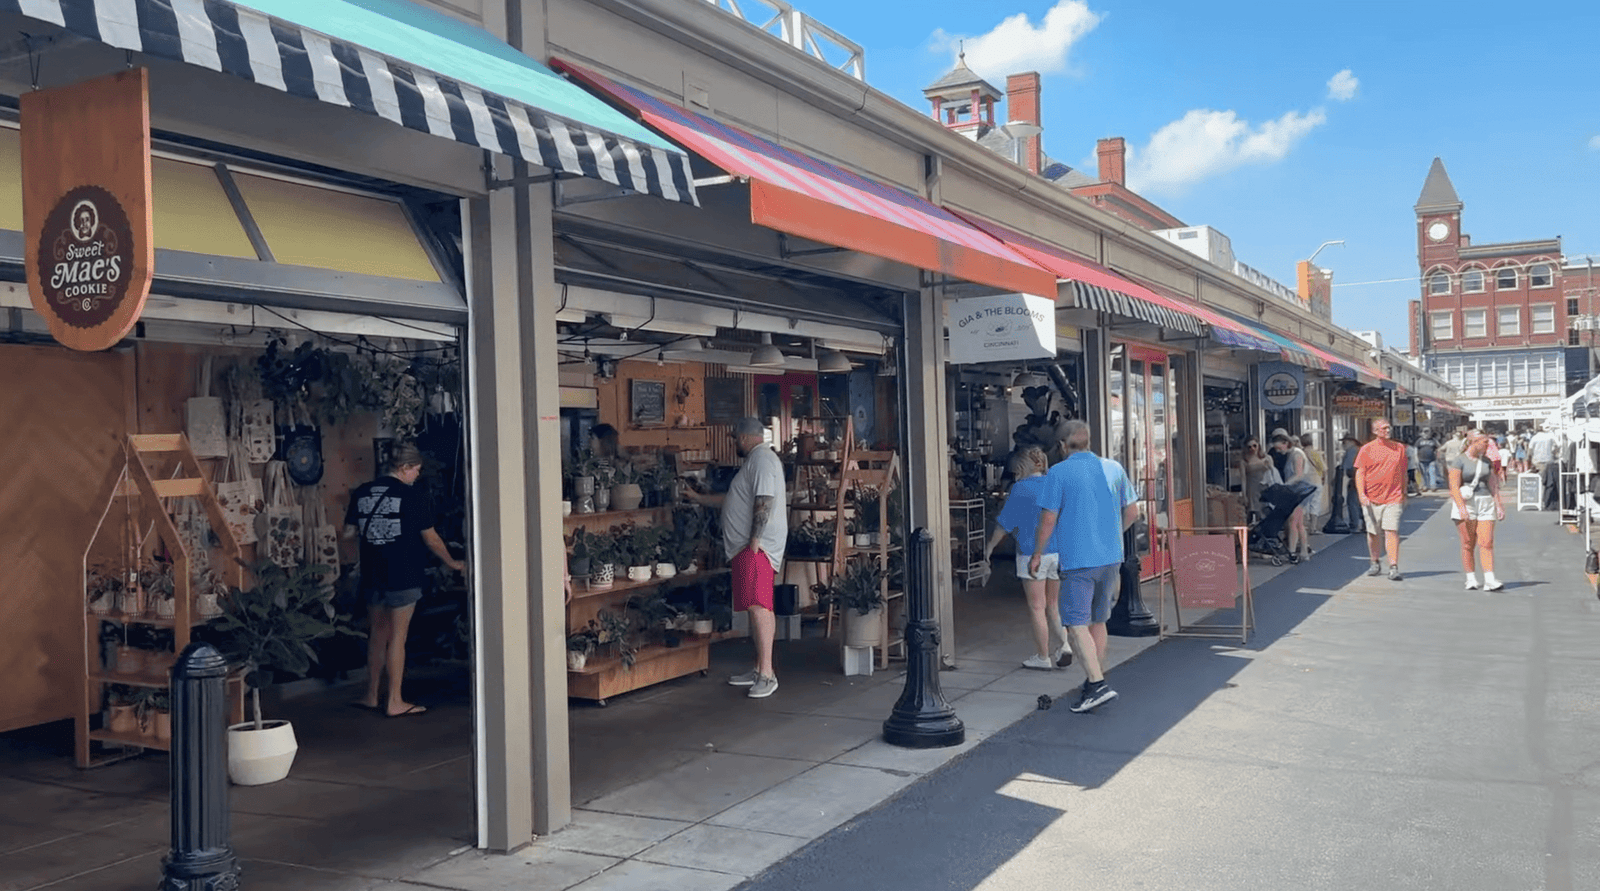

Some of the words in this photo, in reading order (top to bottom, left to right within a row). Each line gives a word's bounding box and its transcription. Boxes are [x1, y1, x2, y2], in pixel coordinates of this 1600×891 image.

[66, 241, 104, 261] Sweet
[65, 283, 108, 298] COOKIE
[958, 314, 975, 328] GIA
[975, 311, 983, 320] &
[984, 306, 1003, 317] THE
[1004, 306, 1045, 323] BLOOMS
[983, 340, 1019, 348] CINCINNATI
